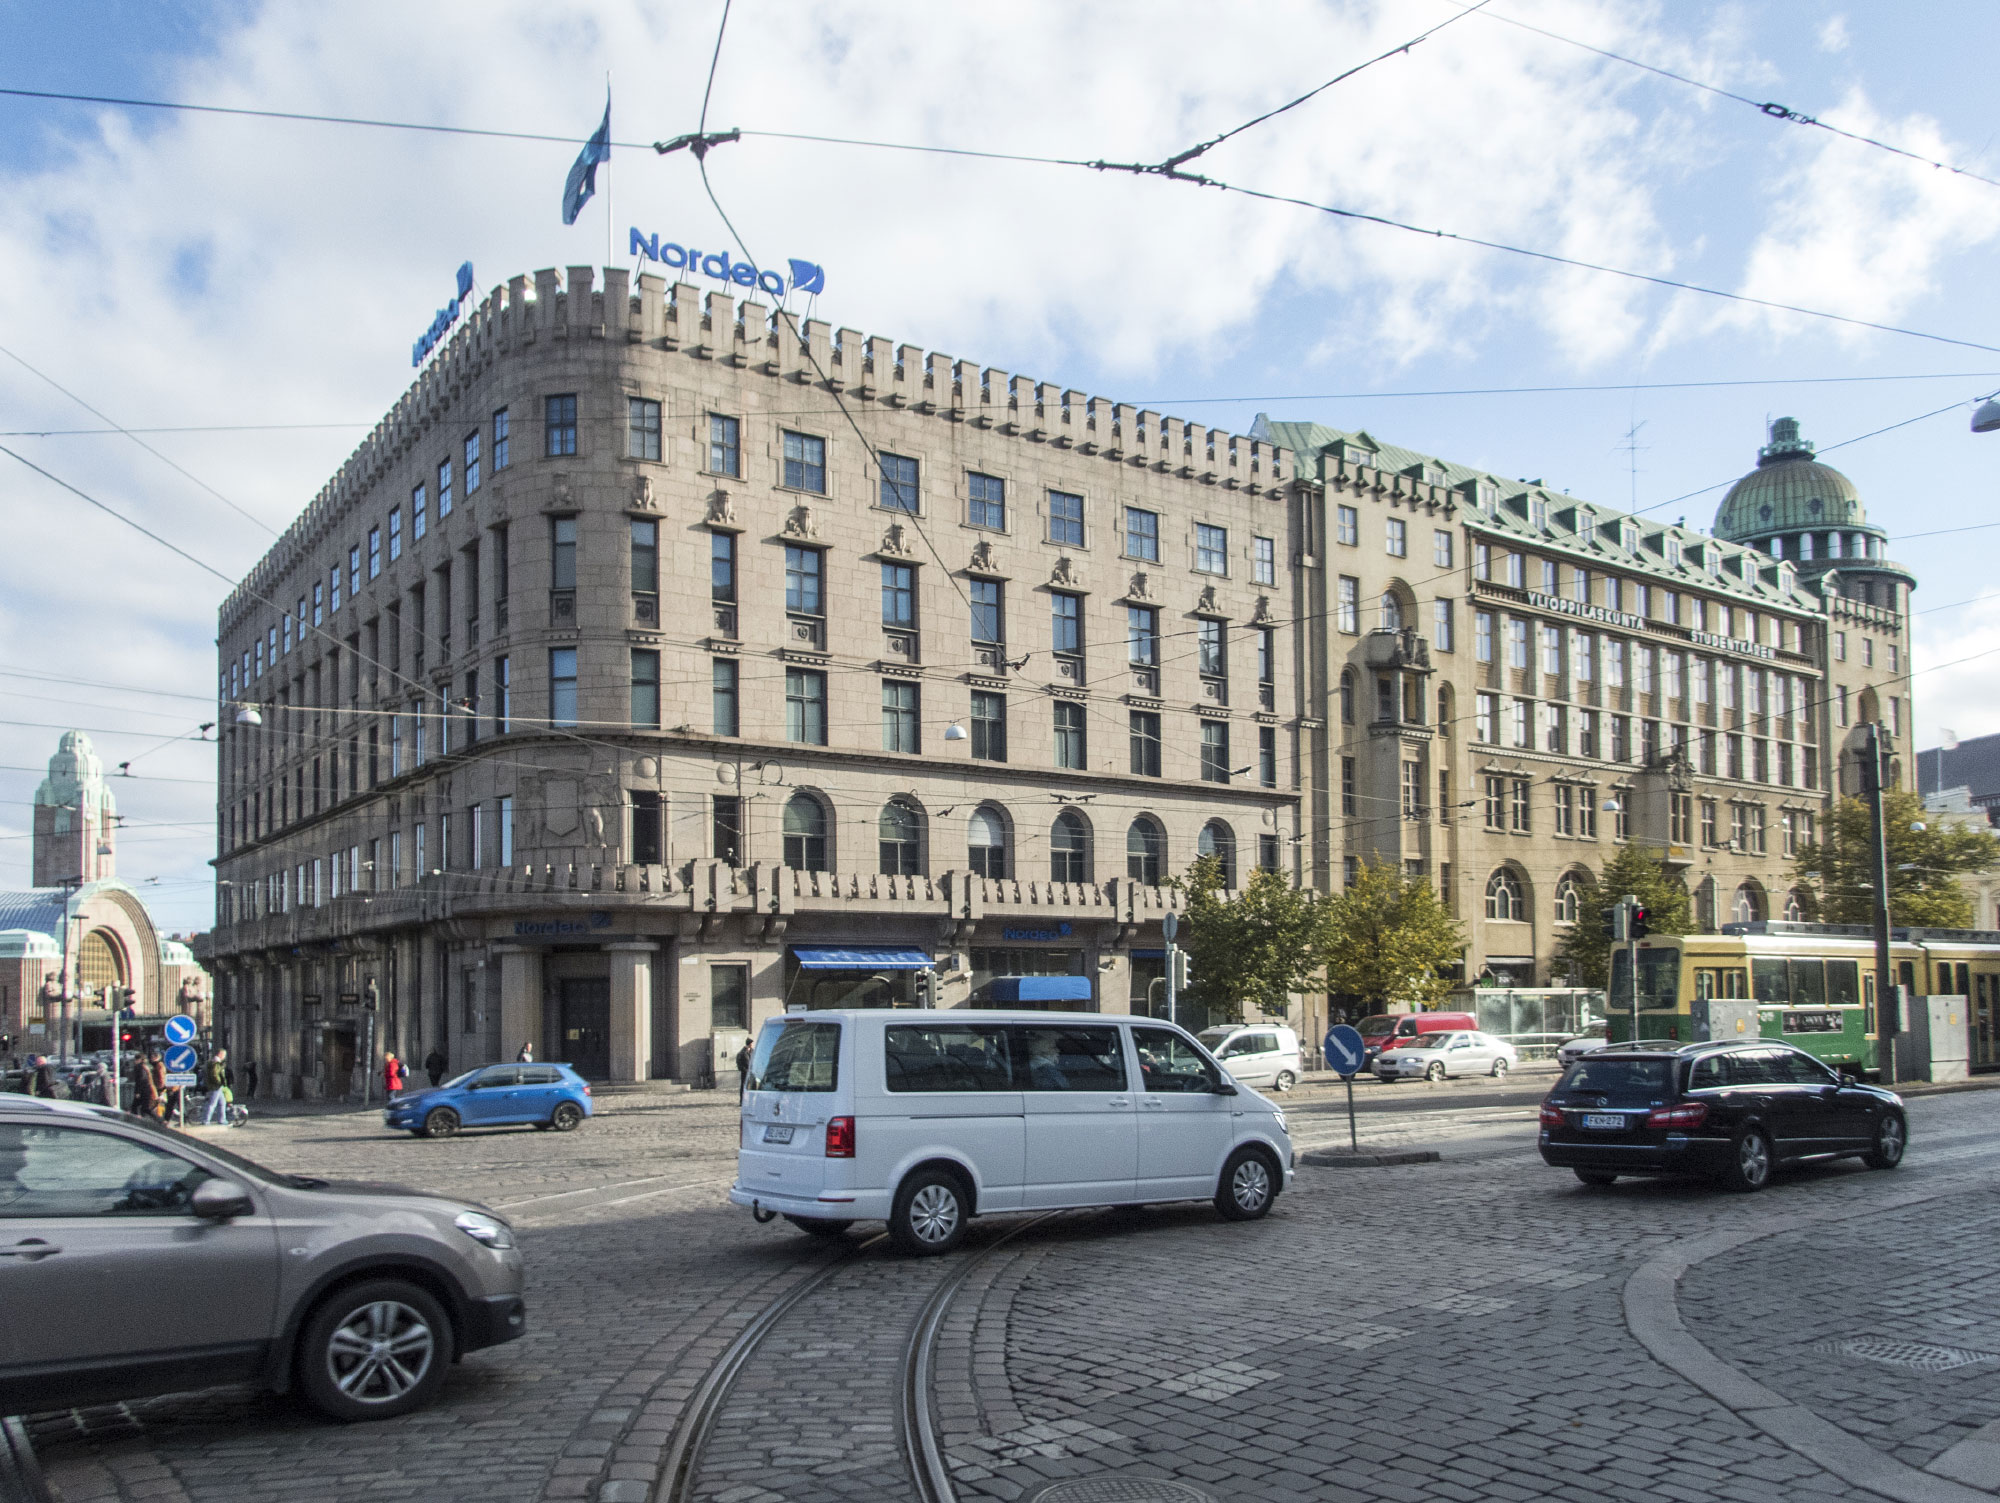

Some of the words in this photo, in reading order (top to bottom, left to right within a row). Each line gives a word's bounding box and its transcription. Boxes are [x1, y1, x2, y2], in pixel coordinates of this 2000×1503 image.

[629, 226, 784, 296] Nordea
[1527, 591, 1645, 630] YLIOPPILASKUNTA
[514, 920, 585, 935] Nordea
[1003, 927, 1058, 941] Nordea
